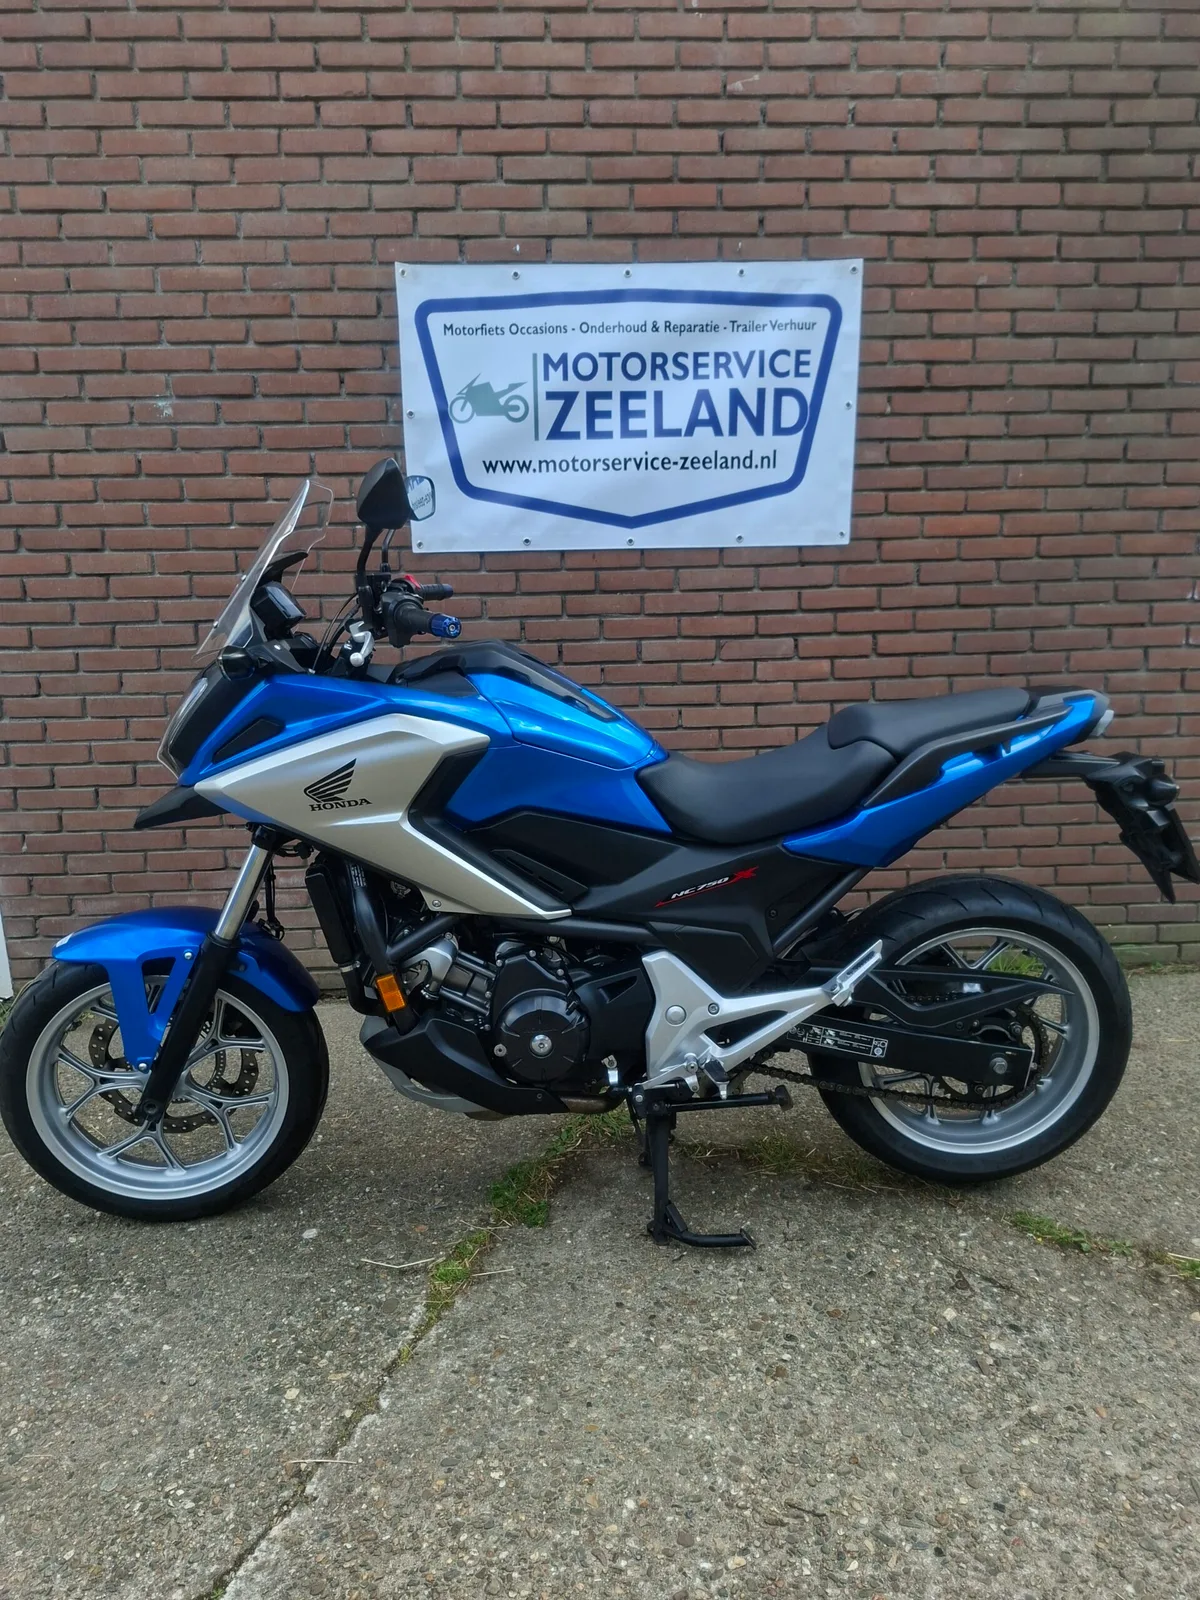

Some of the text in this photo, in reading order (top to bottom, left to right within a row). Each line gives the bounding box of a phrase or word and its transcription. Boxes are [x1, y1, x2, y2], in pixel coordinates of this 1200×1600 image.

[443, 323, 506, 336] Motorfiets
[508, 322, 569, 336] Occasions
[579, 320, 648, 335] Onderhoud
[651, 321, 660, 333] &
[664, 320, 720, 337] Reparatie
[729, 320, 768, 332] Trailer
[769, 319, 817, 332] Verhuur
[542, 348, 812, 382] MOTORSERVICE
[545, 387, 809, 441] ZEELAND
[482, 450, 778, 476] www.motorservice-zeeland.nl
[308, 798, 373, 812] HONDA
